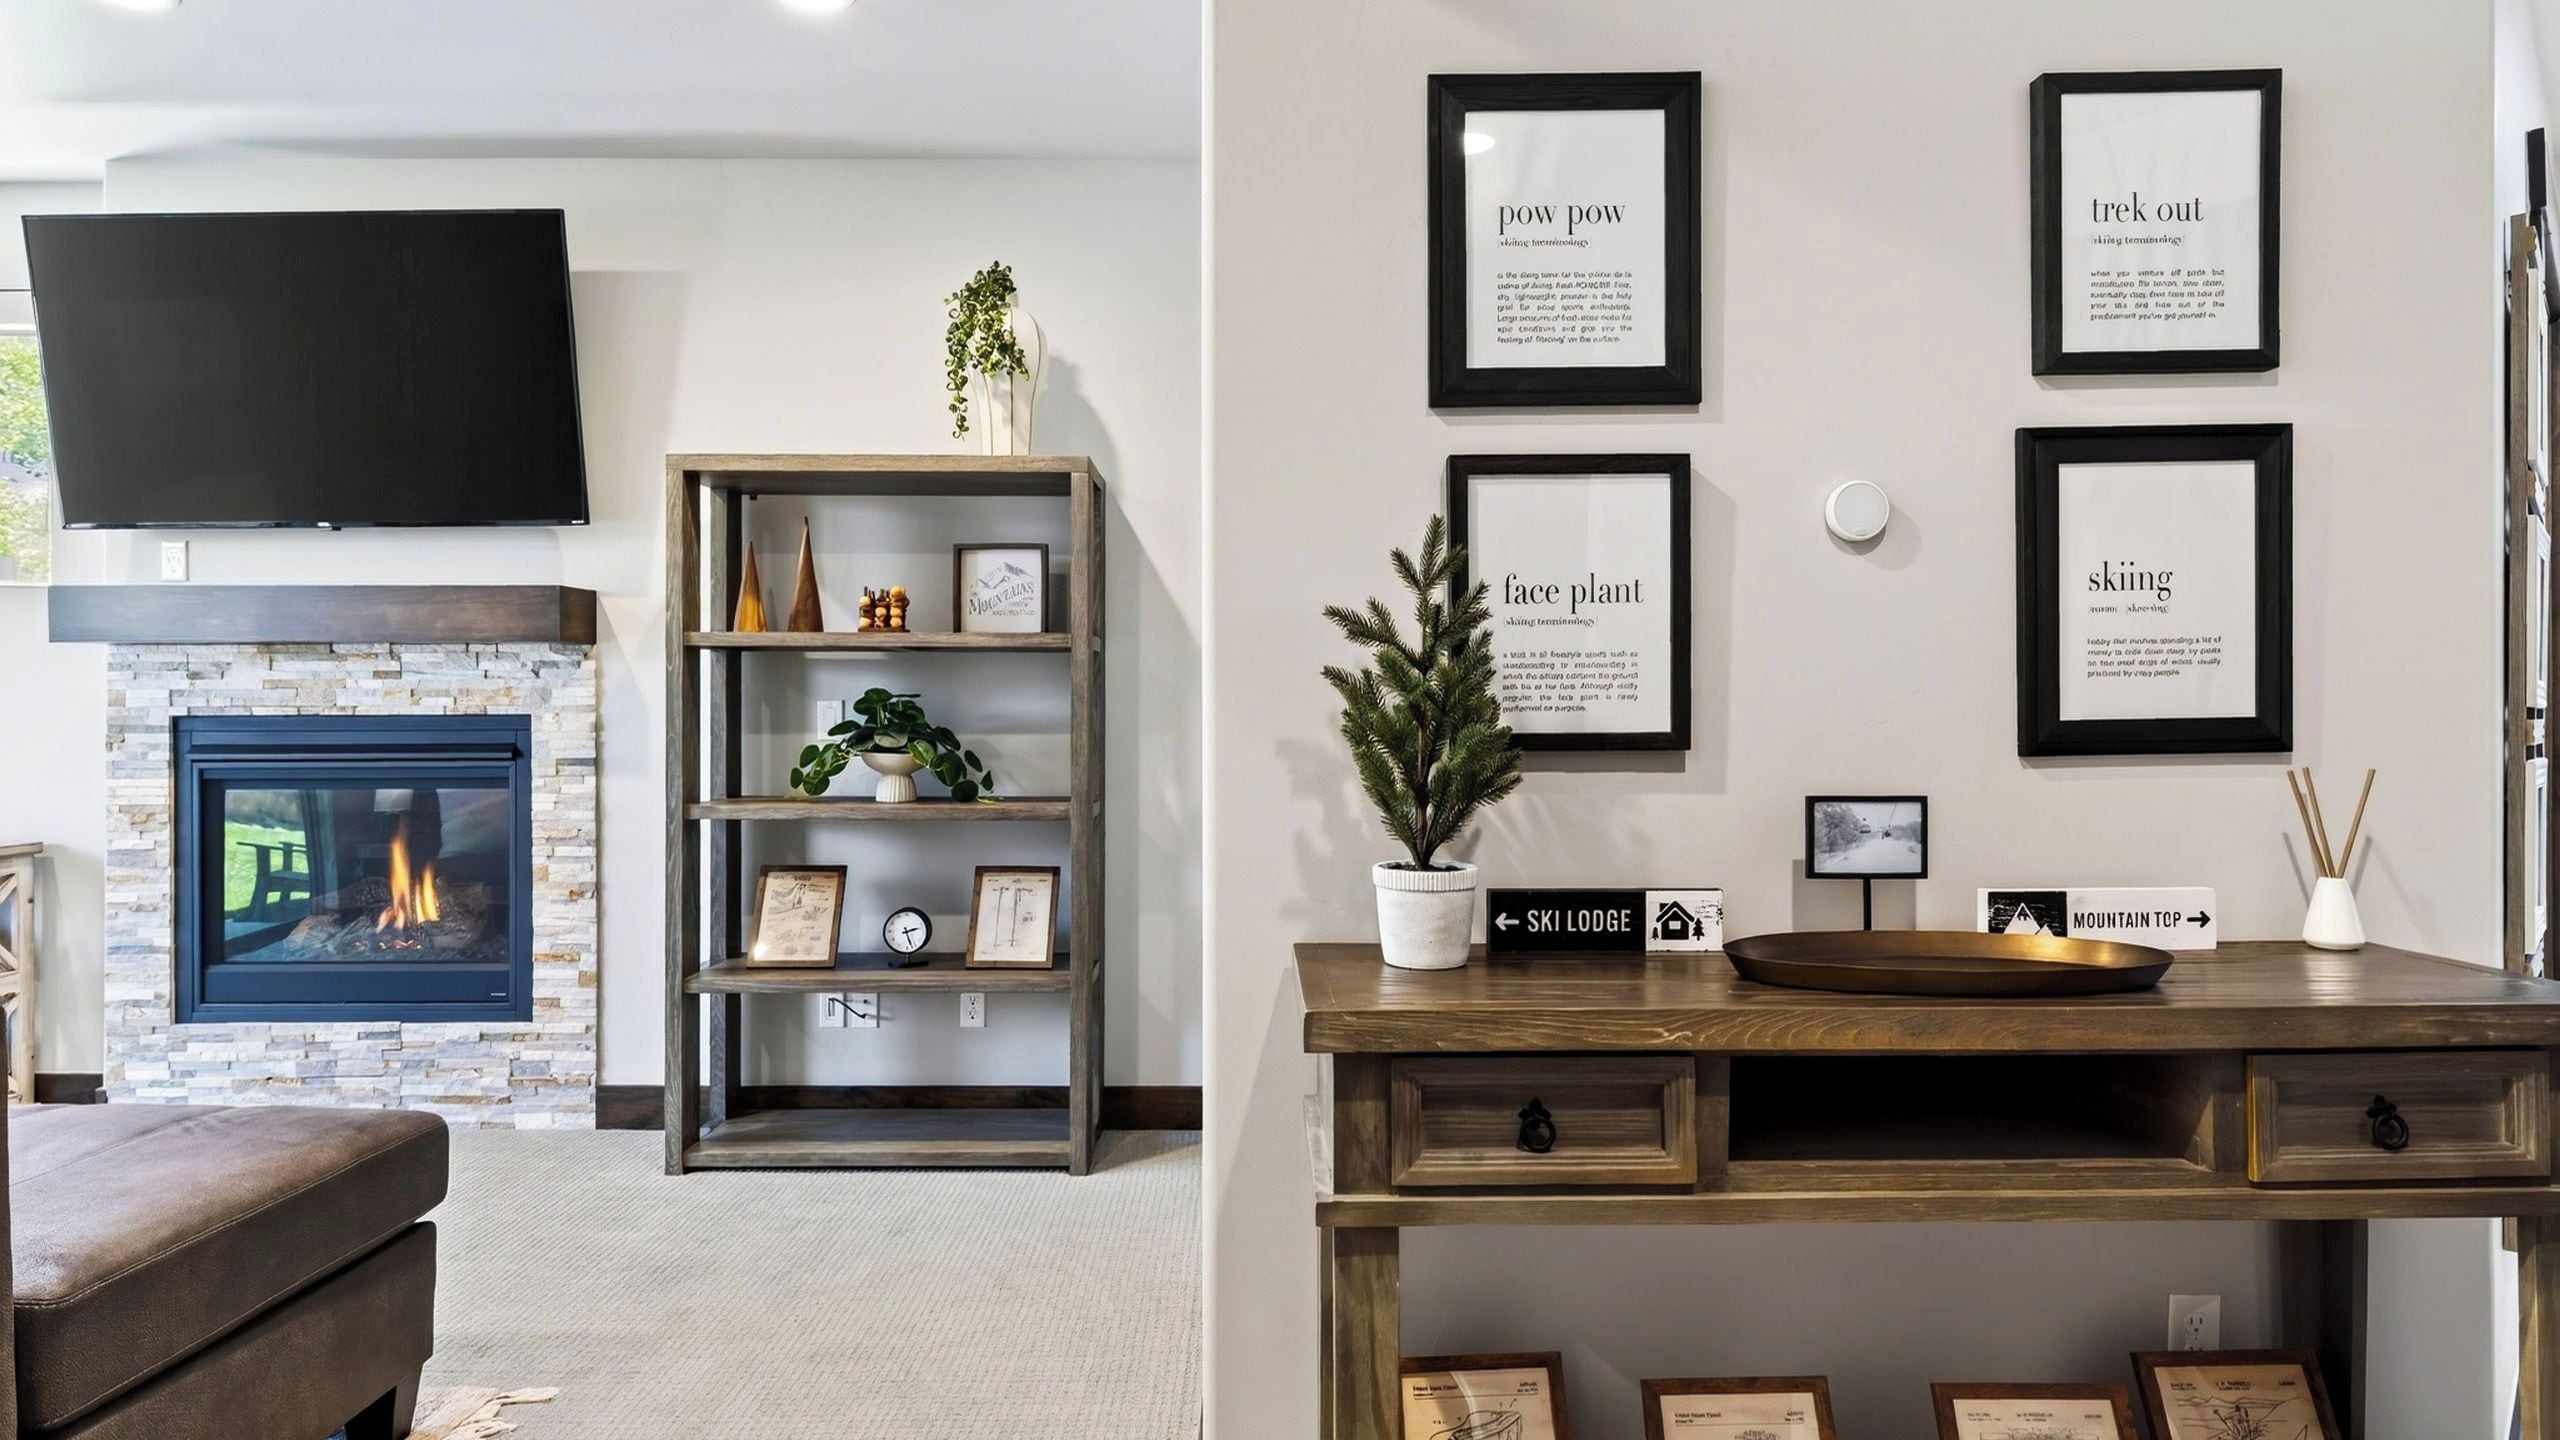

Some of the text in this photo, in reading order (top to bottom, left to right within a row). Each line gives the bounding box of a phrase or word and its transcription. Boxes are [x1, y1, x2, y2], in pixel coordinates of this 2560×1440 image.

[1499, 205, 1626, 236] pow pow
[2091, 191, 2206, 223] trek out
[1503, 573, 1644, 615] face plant
[2088, 560, 2174, 602] skiing
[1527, 909, 1631, 933] SKI LODGE
[2073, 911, 2181, 929] MOUNTAIN TOP
